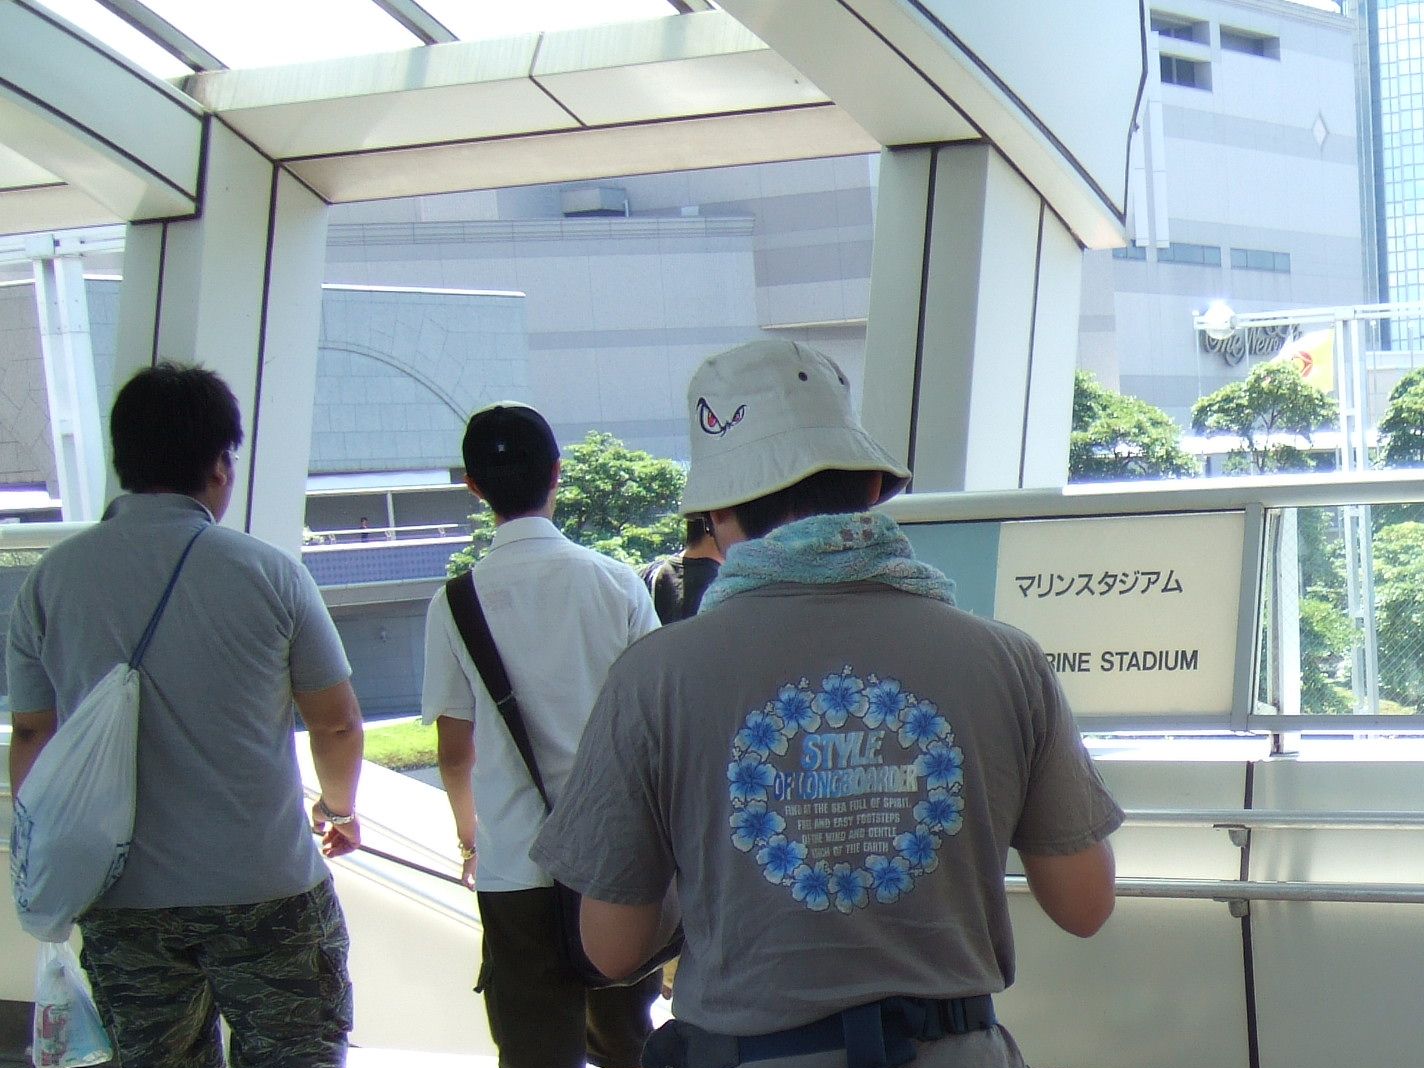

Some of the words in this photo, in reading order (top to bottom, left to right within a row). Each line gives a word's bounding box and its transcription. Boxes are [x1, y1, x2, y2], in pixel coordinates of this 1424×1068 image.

[1015, 570, 1183, 598] マリンスタジアム
[1045, 652, 1092, 673] RINE
[1100, 649, 1199, 672] STADIUM
[801, 730, 886, 771] STYLE
[773, 771, 795, 801] OF
